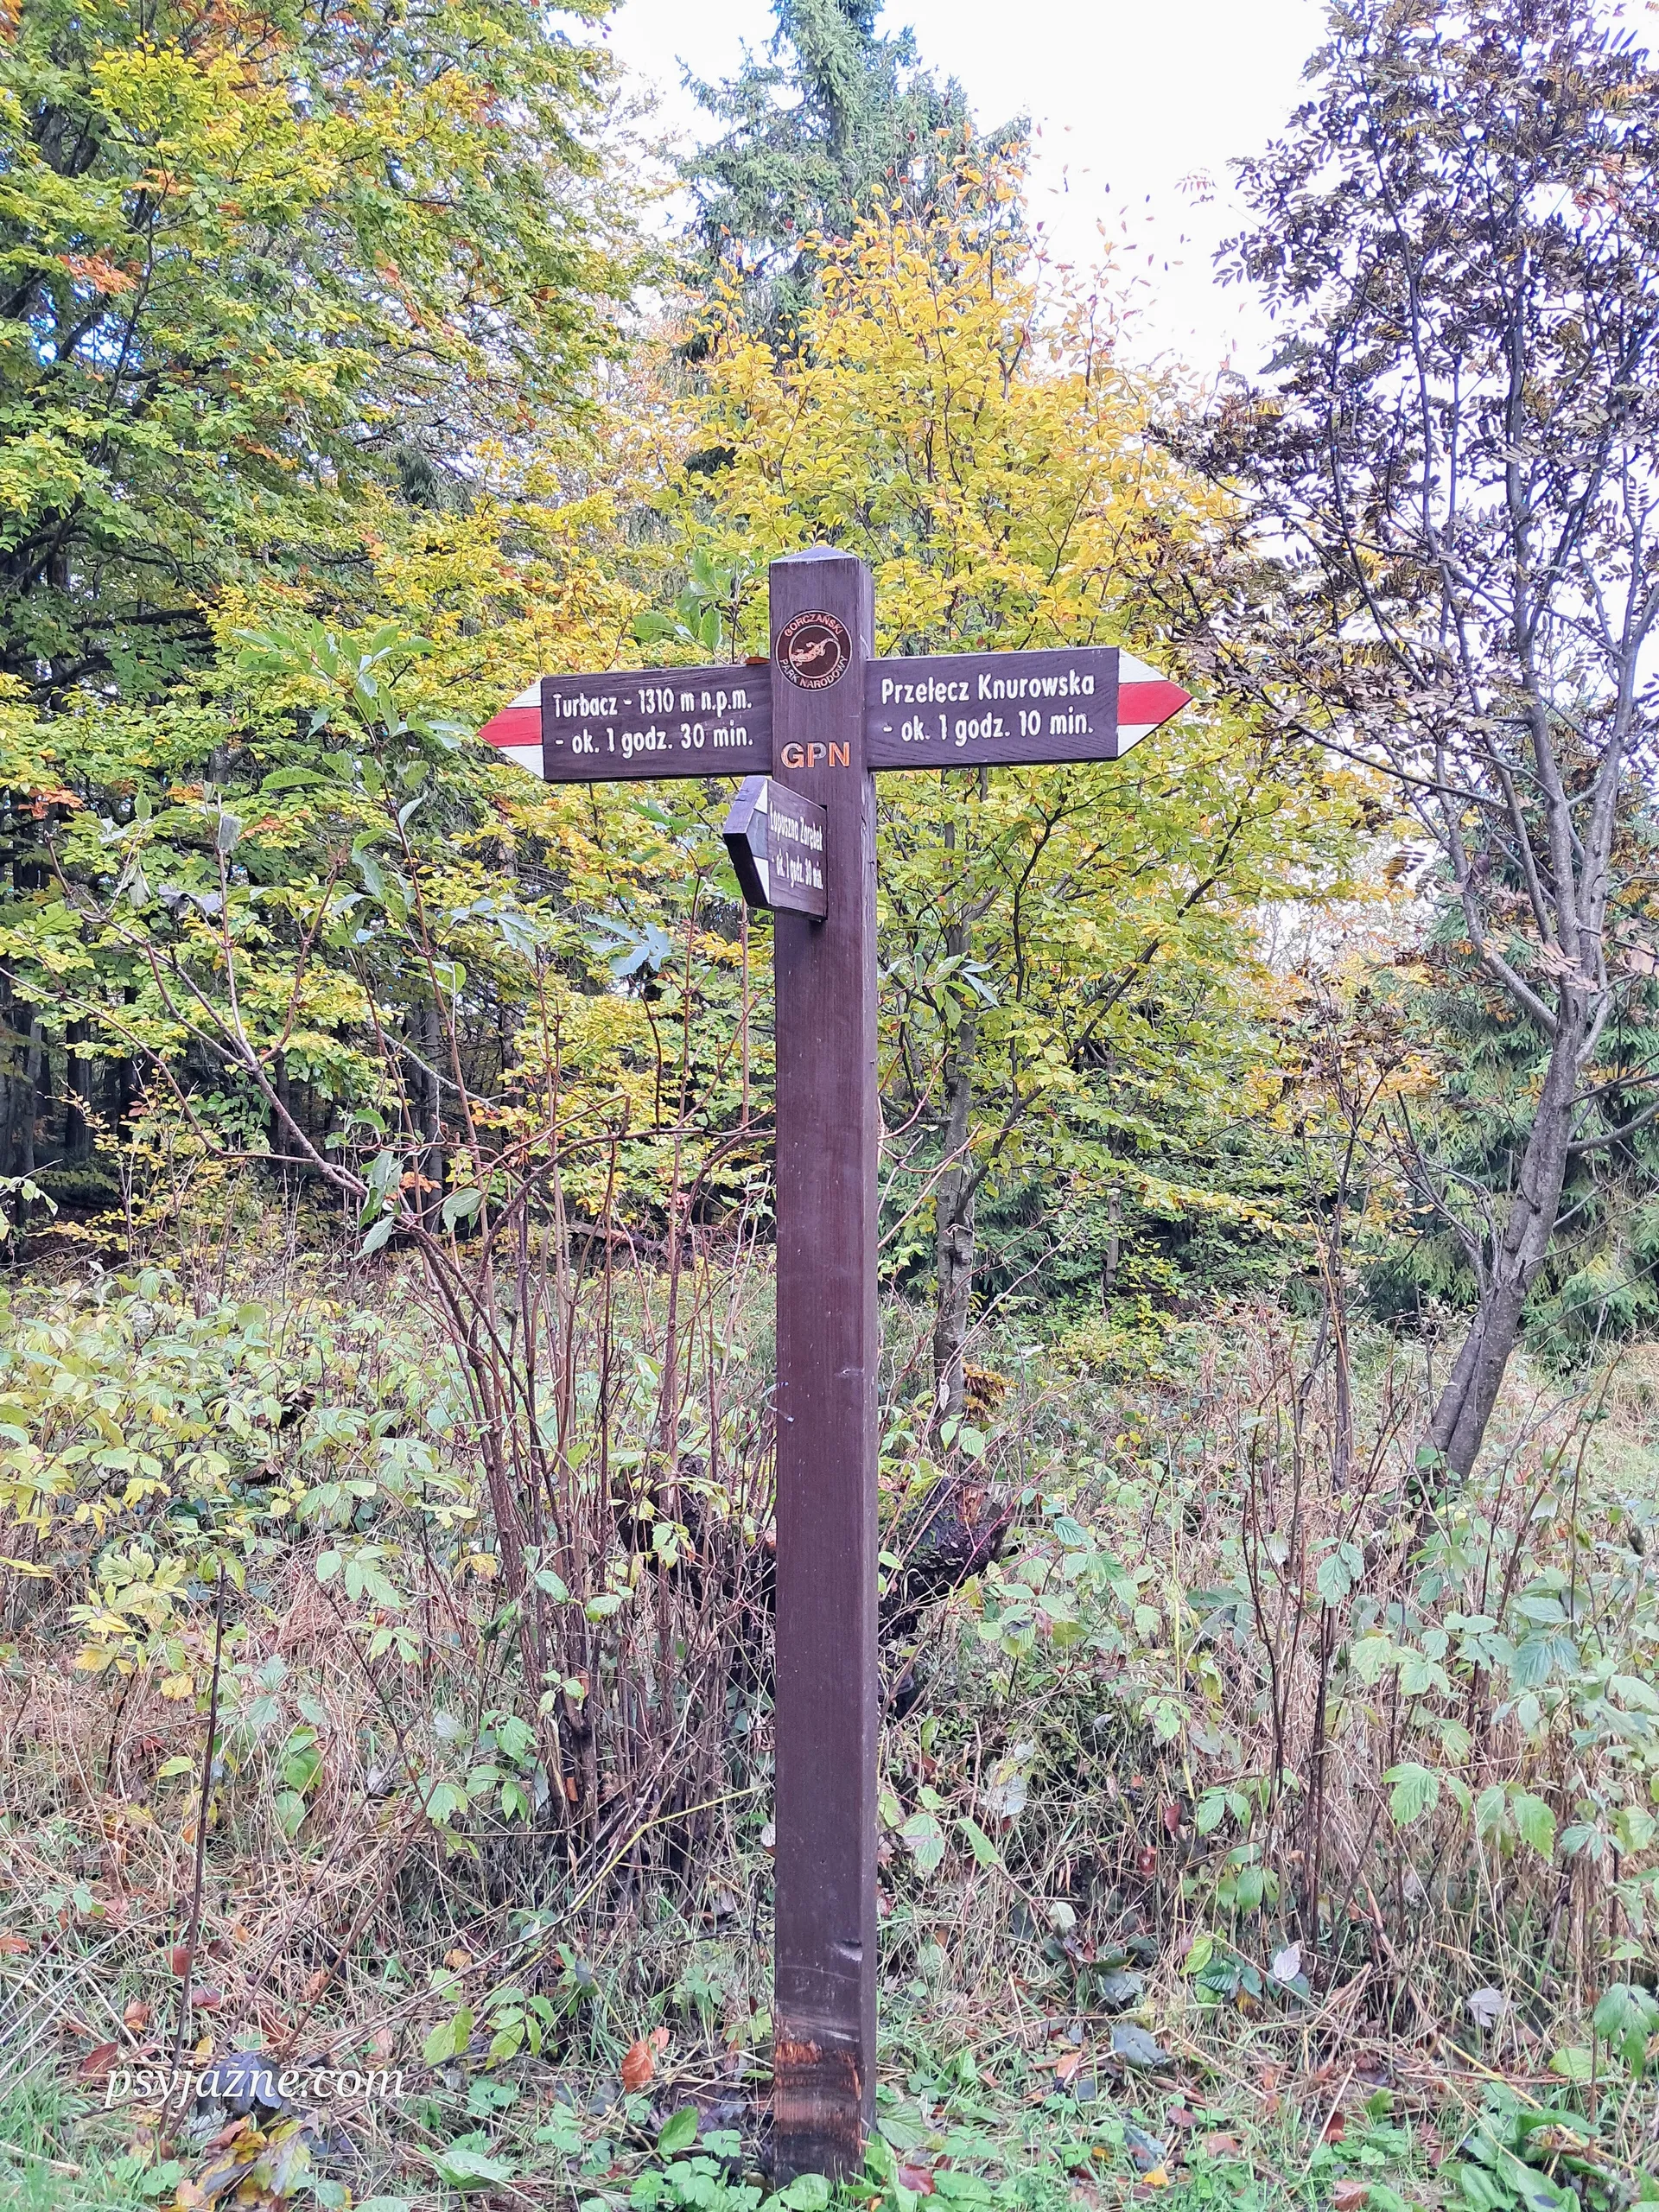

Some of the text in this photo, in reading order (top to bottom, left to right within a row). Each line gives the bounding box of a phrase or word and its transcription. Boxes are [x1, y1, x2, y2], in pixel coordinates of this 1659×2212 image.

[779, 655, 849, 689] PARK NARODOWY
[977, 669, 1095, 701] Knurowska
[552, 692, 618, 718] Turbacz
[638, 688, 674, 715] 1310
[680, 693, 695, 713] m
[701, 689, 752, 718] n.p.m.
[571, 728, 600, 754] ok.
[607, 728, 614, 753] 1
[620, 725, 673, 760] godz.
[680, 722, 705, 749] 30
[713, 719, 753, 747] min.
[901, 715, 931, 741] ok.
[938, 714, 947, 741] 1
[955, 711, 1010, 747] godz.
[1019, 709, 1041, 737] 10
[1049, 705, 1094, 734] min.
[781, 741, 850, 768] GPN
[776, 847, 785, 877] ok.
[785, 851, 790, 879] 1
[790, 855, 804, 888] godz.
[813, 861, 823, 890] min.
